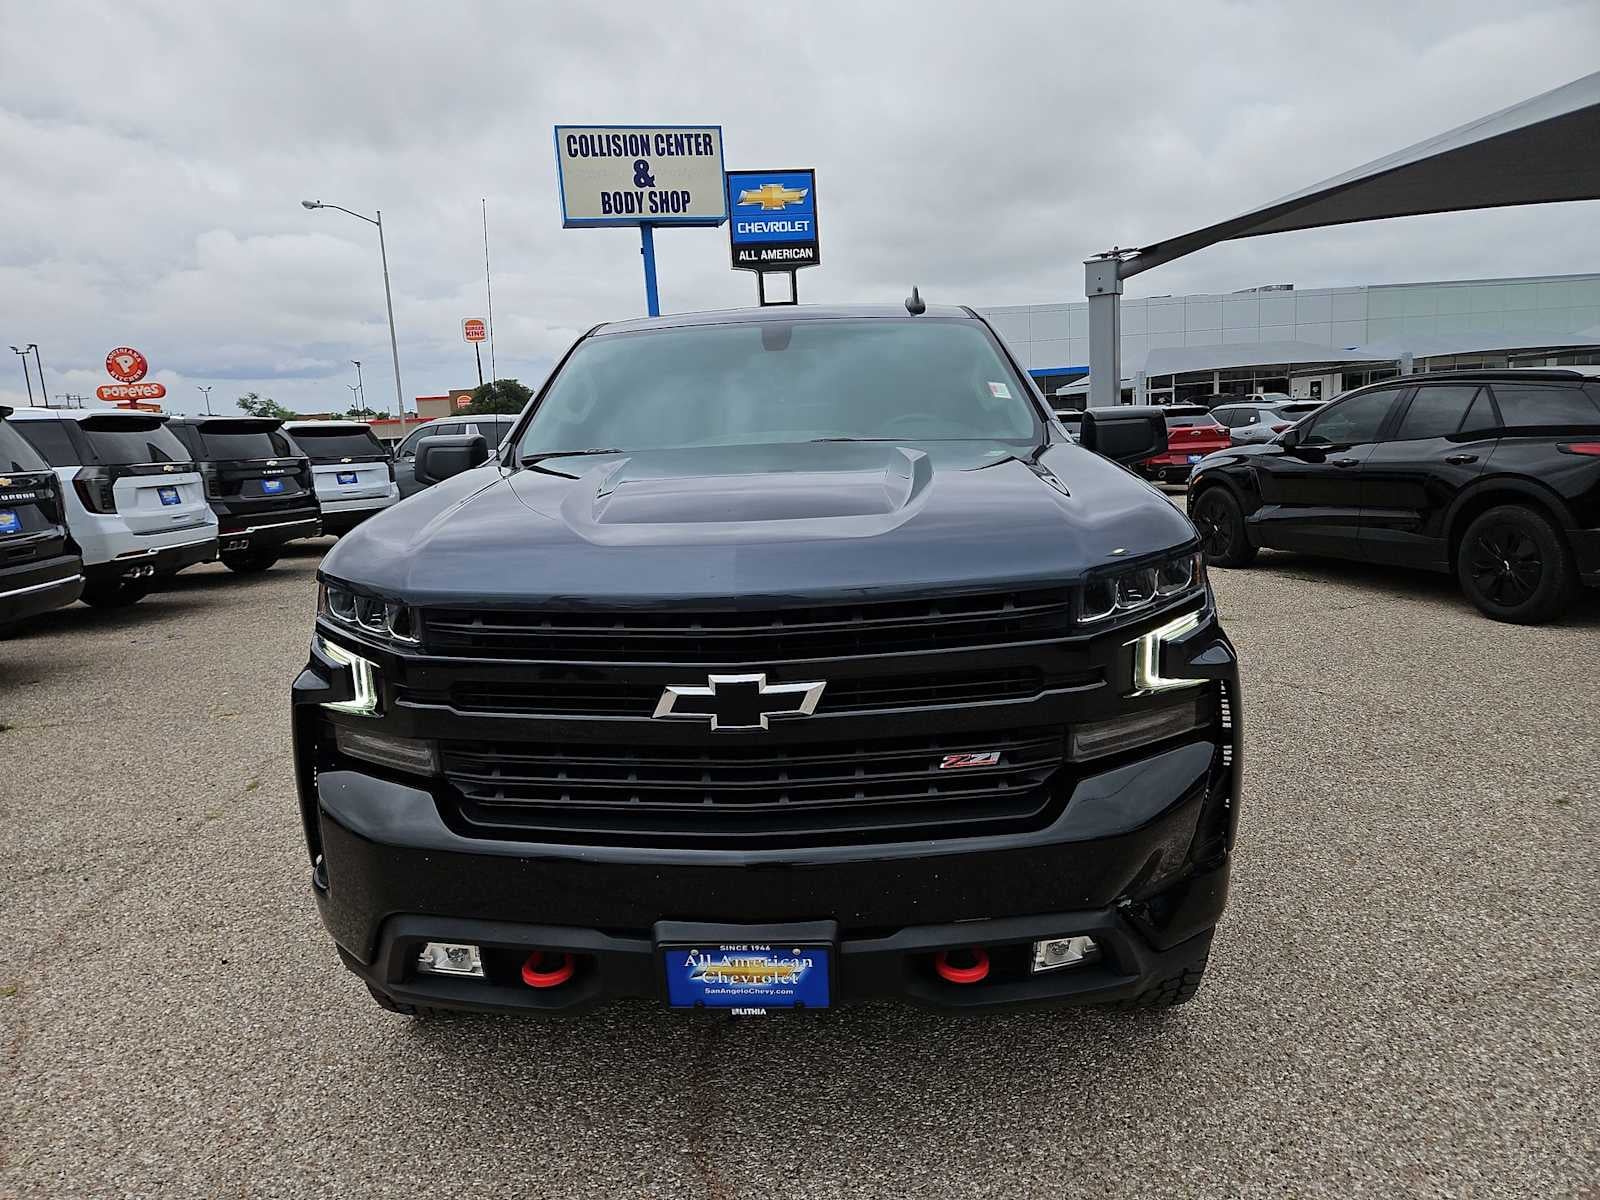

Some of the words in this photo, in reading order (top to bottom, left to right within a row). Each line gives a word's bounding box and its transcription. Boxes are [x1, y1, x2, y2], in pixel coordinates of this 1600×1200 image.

[566, 134, 651, 158] COLLISION
[654, 133, 714, 157] CENTER
[633, 159, 656, 188] &
[600, 191, 644, 214] BODY
[648, 190, 691, 213] SHOP
[737, 220, 810, 234] CHEVROLET
[739, 250, 758, 261] ALL
[760, 247, 813, 260] AMERICAN
[684, 954, 711, 967] All
[719, 954, 813, 968] American
[702, 970, 799, 985] Chevrolet
[704, 987, 794, 995] SanAngeloChevy.com
[739, 1007, 767, 1016] LITHIA
